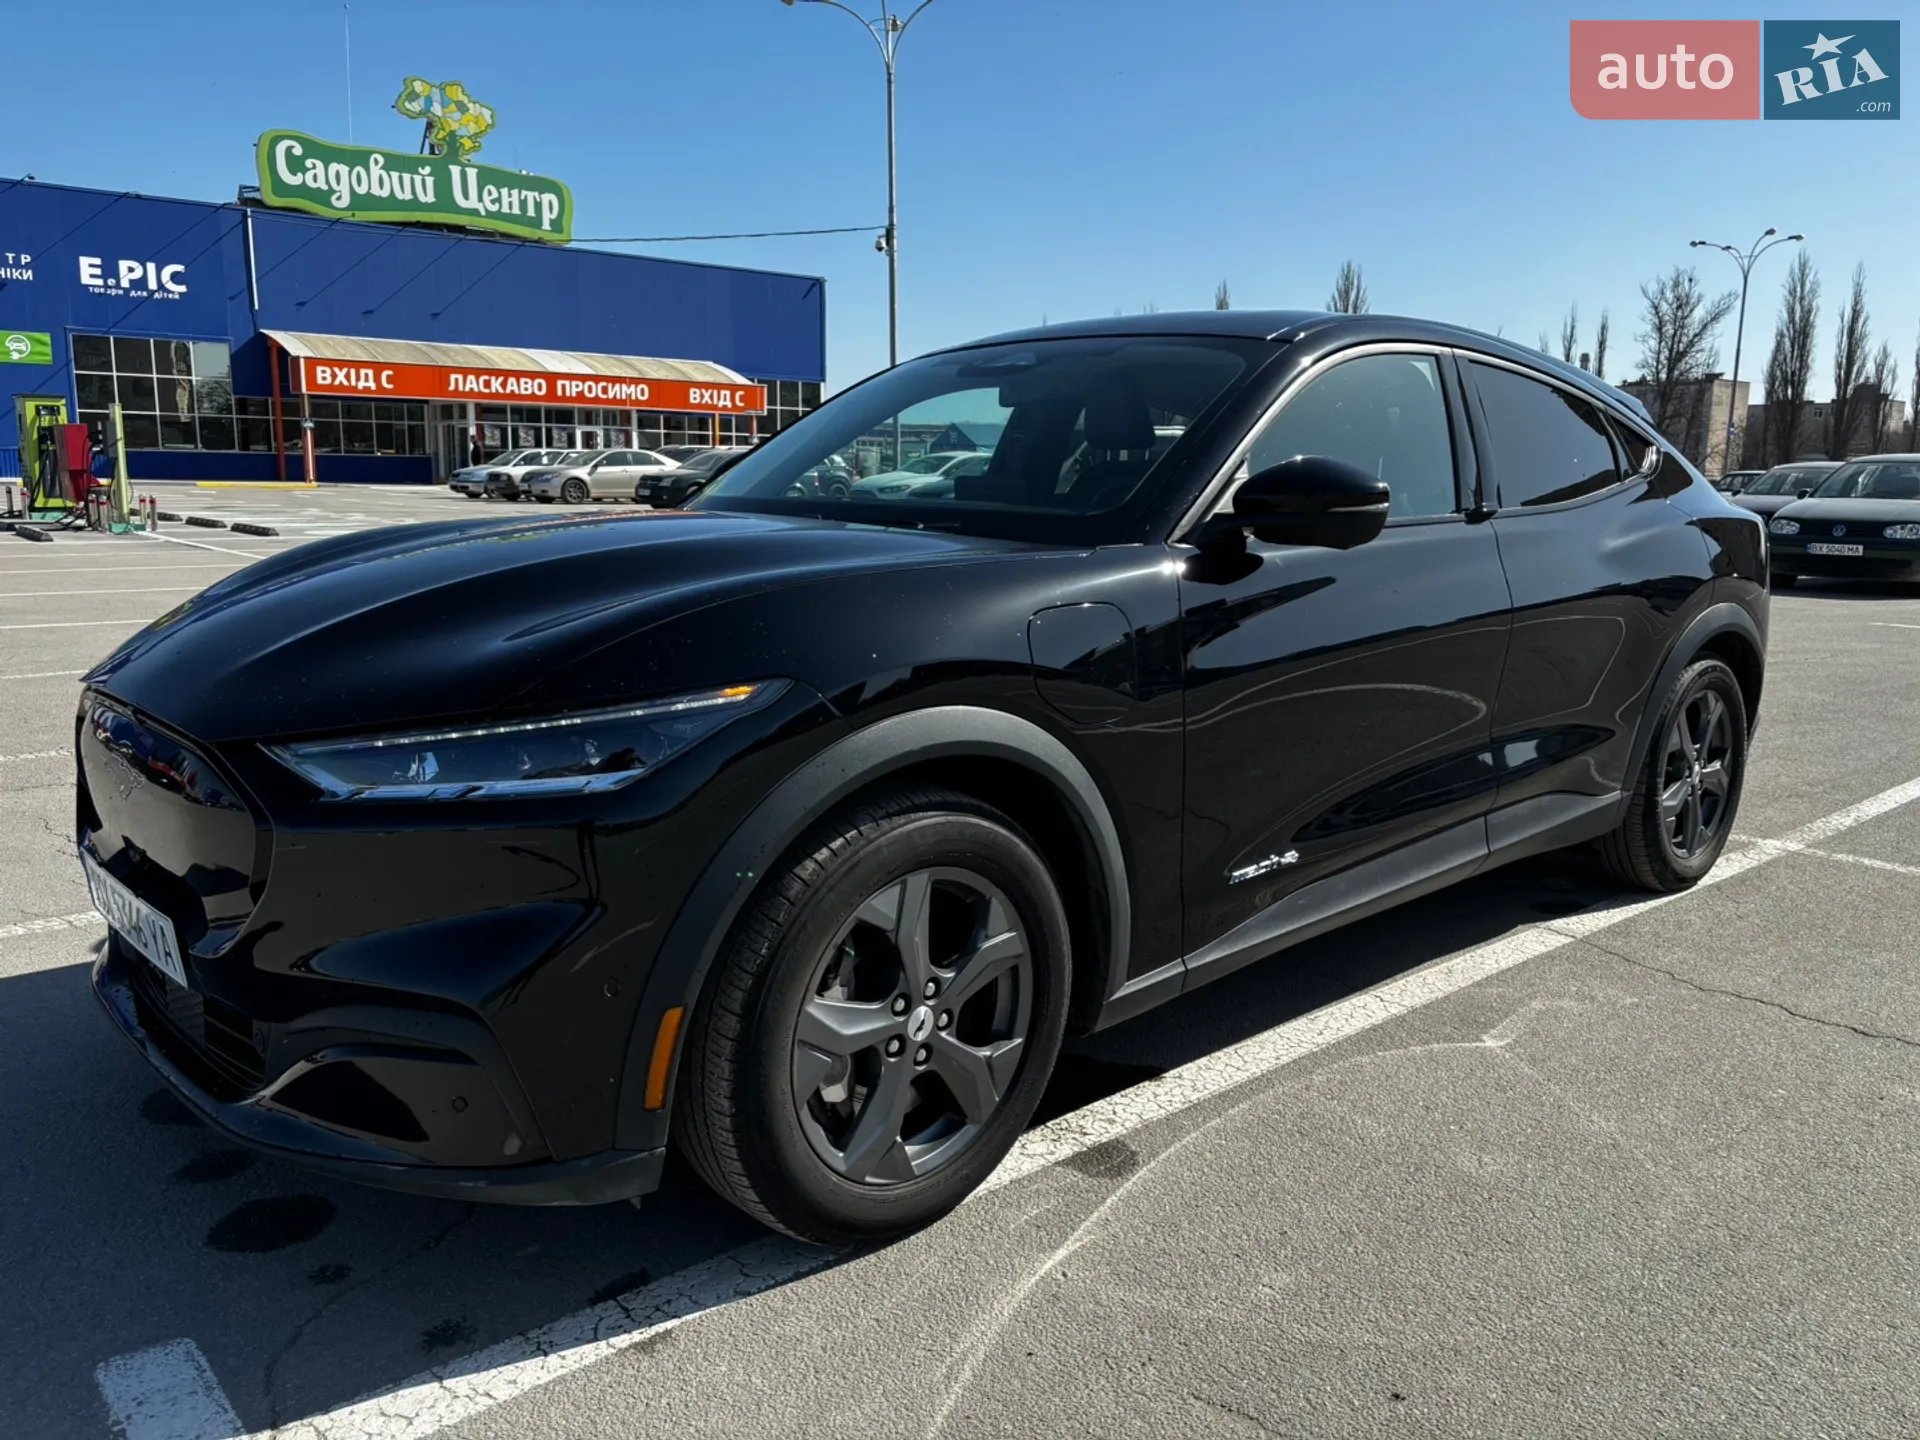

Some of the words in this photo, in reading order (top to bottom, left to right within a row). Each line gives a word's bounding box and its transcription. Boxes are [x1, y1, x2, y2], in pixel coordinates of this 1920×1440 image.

[274, 139, 437, 208] Садовий
[448, 164, 559, 231] Центр
[129, 289, 148, 299] для
[314, 364, 377, 390] ВХІД
[381, 369, 395, 390] С
[447, 373, 547, 397] ЛАСКАВО
[556, 379, 650, 401] ПРОСИМО
[688, 387, 732, 408] ВХІД
[734, 390, 745, 408] С
